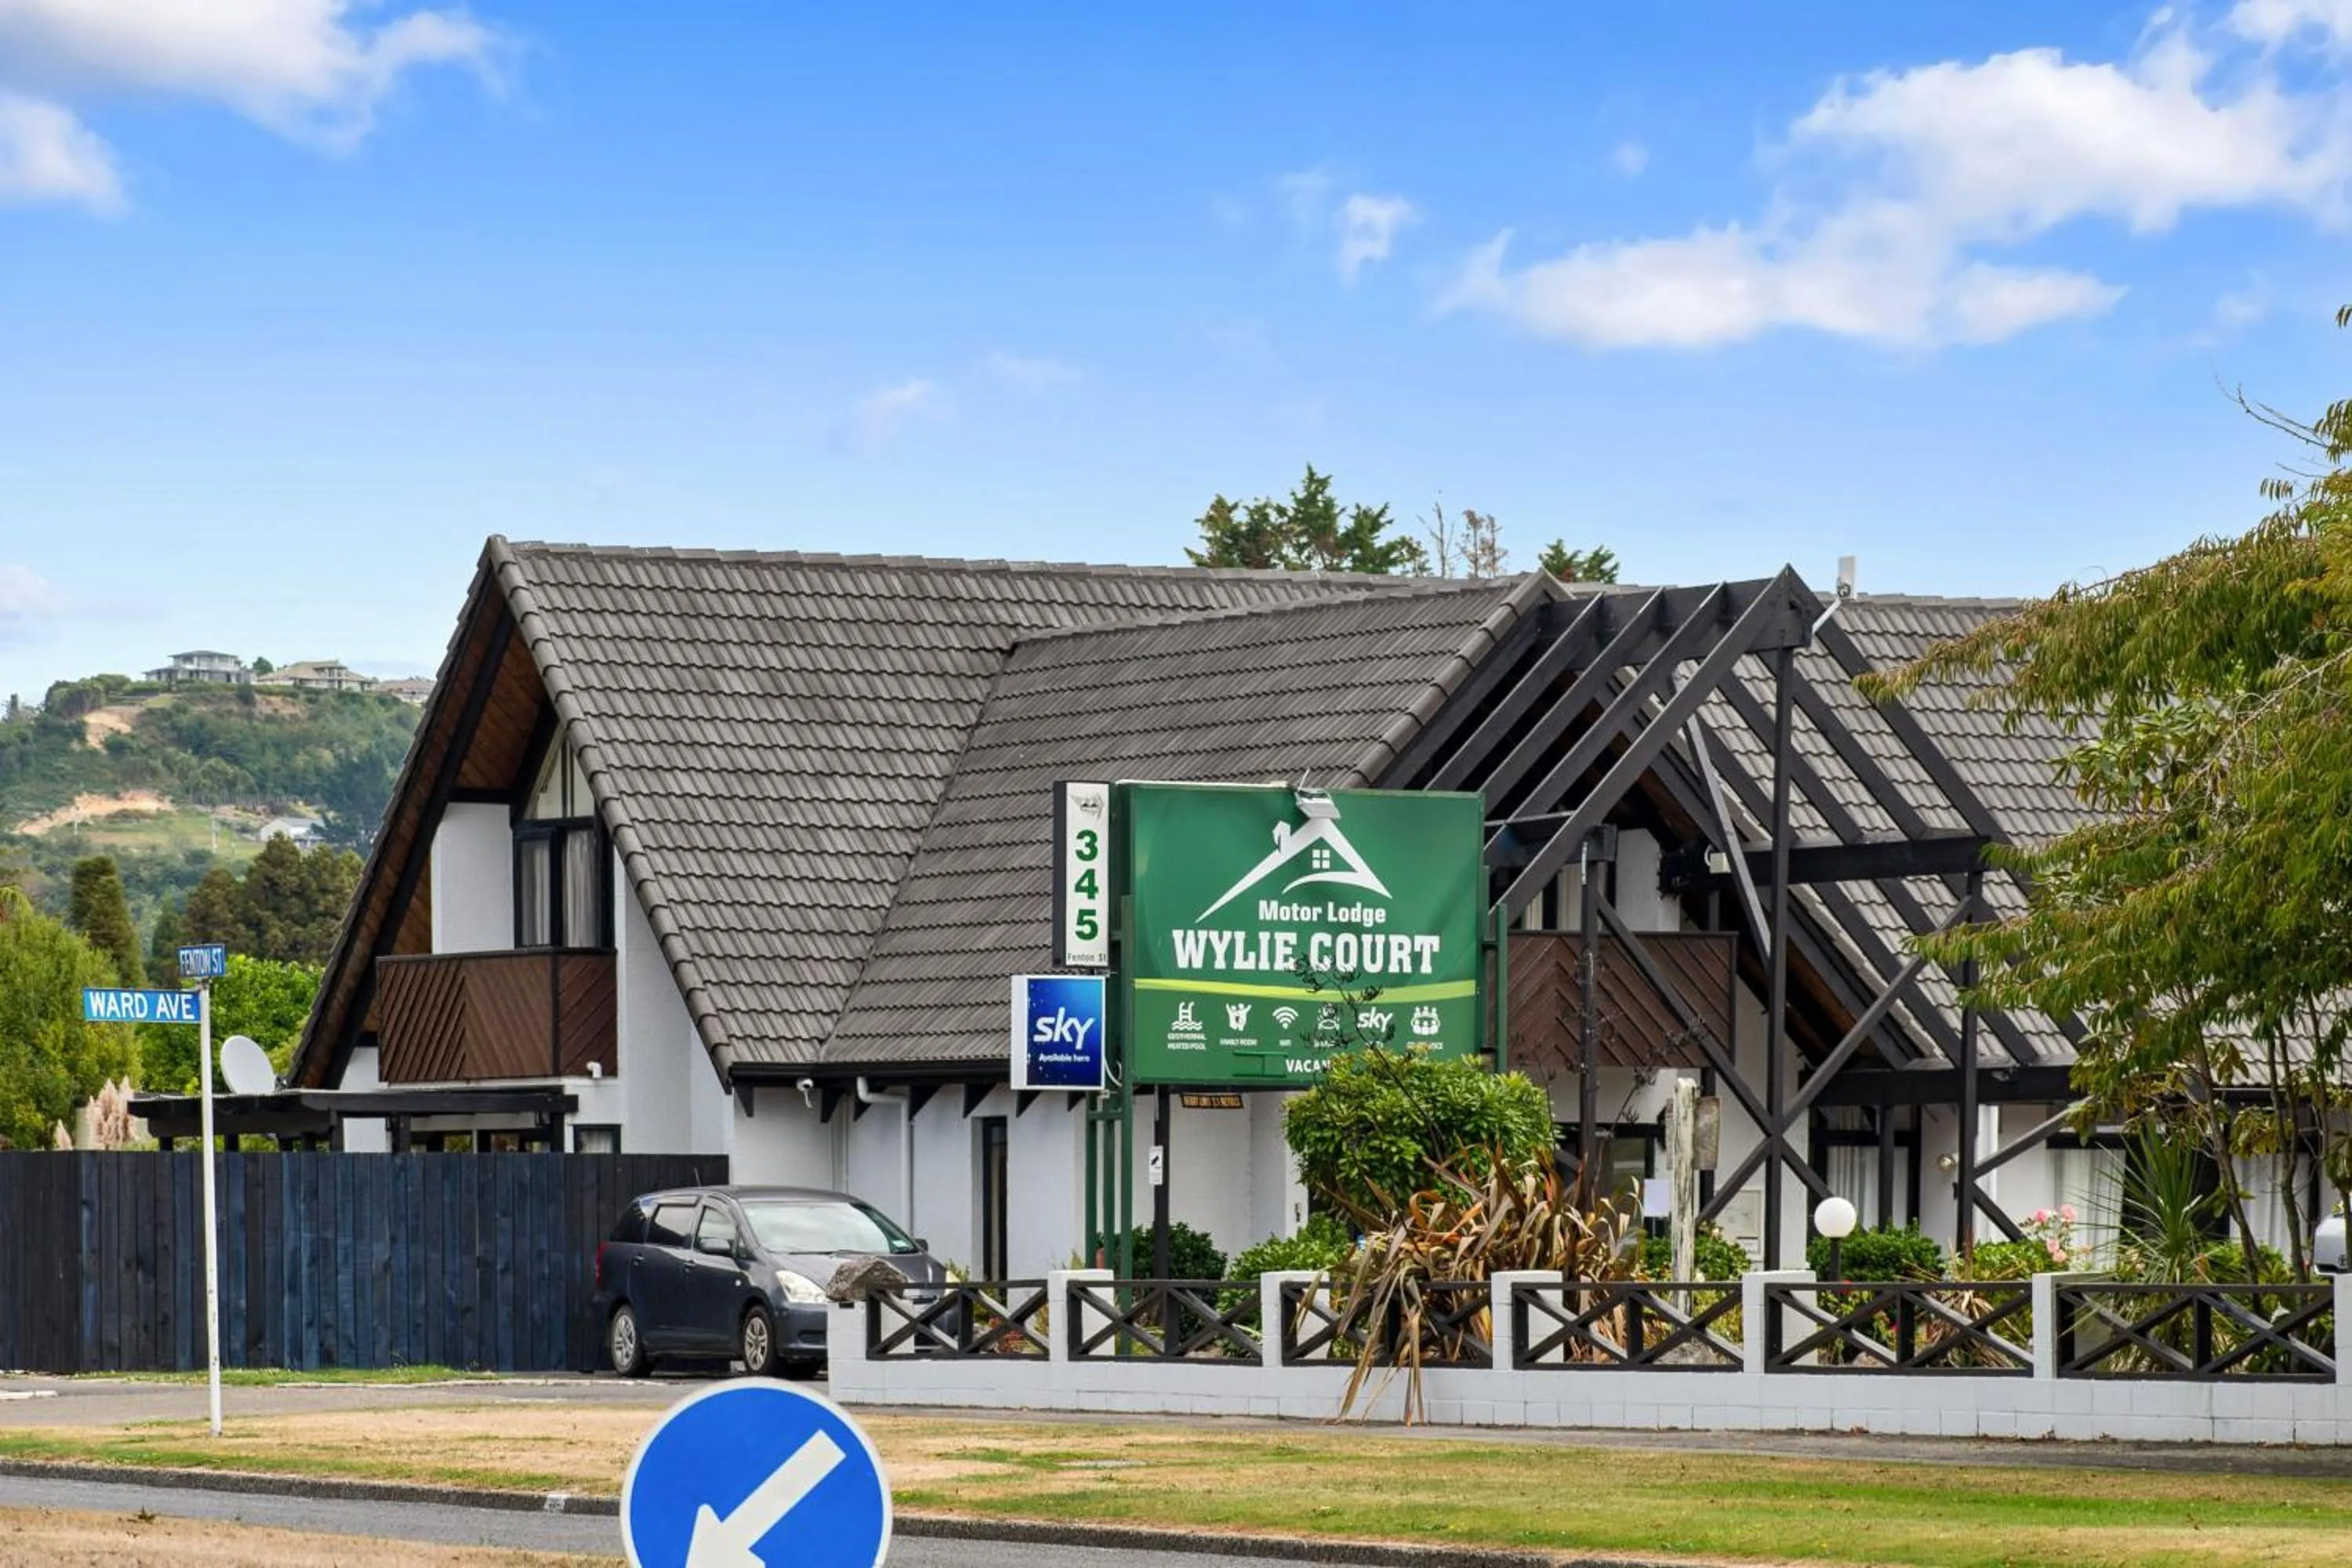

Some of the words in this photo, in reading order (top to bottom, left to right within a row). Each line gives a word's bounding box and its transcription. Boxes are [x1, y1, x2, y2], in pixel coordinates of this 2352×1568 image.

[1074, 829, 1099, 941] 345
[1258, 900, 1322, 923] Motor
[1327, 902, 1387, 927] Lodge
[180, 948, 210, 975] FENTON
[212, 947, 223, 973] ST
[1068, 953, 1095, 963] Fenton
[1098, 953, 1106, 962] St
[1172, 929, 1298, 971] WYLIE
[1309, 932, 1440, 974] COURT
[89, 991, 148, 1018] WARD
[157, 993, 195, 1020] AVE
[1033, 1006, 1096, 1051] sky
[1356, 1007, 1393, 1033] sky
[1039, 1053, 1073, 1062] Available
[1073, 1054, 1091, 1062] here
[1286, 1058, 1331, 1073] VACAN
